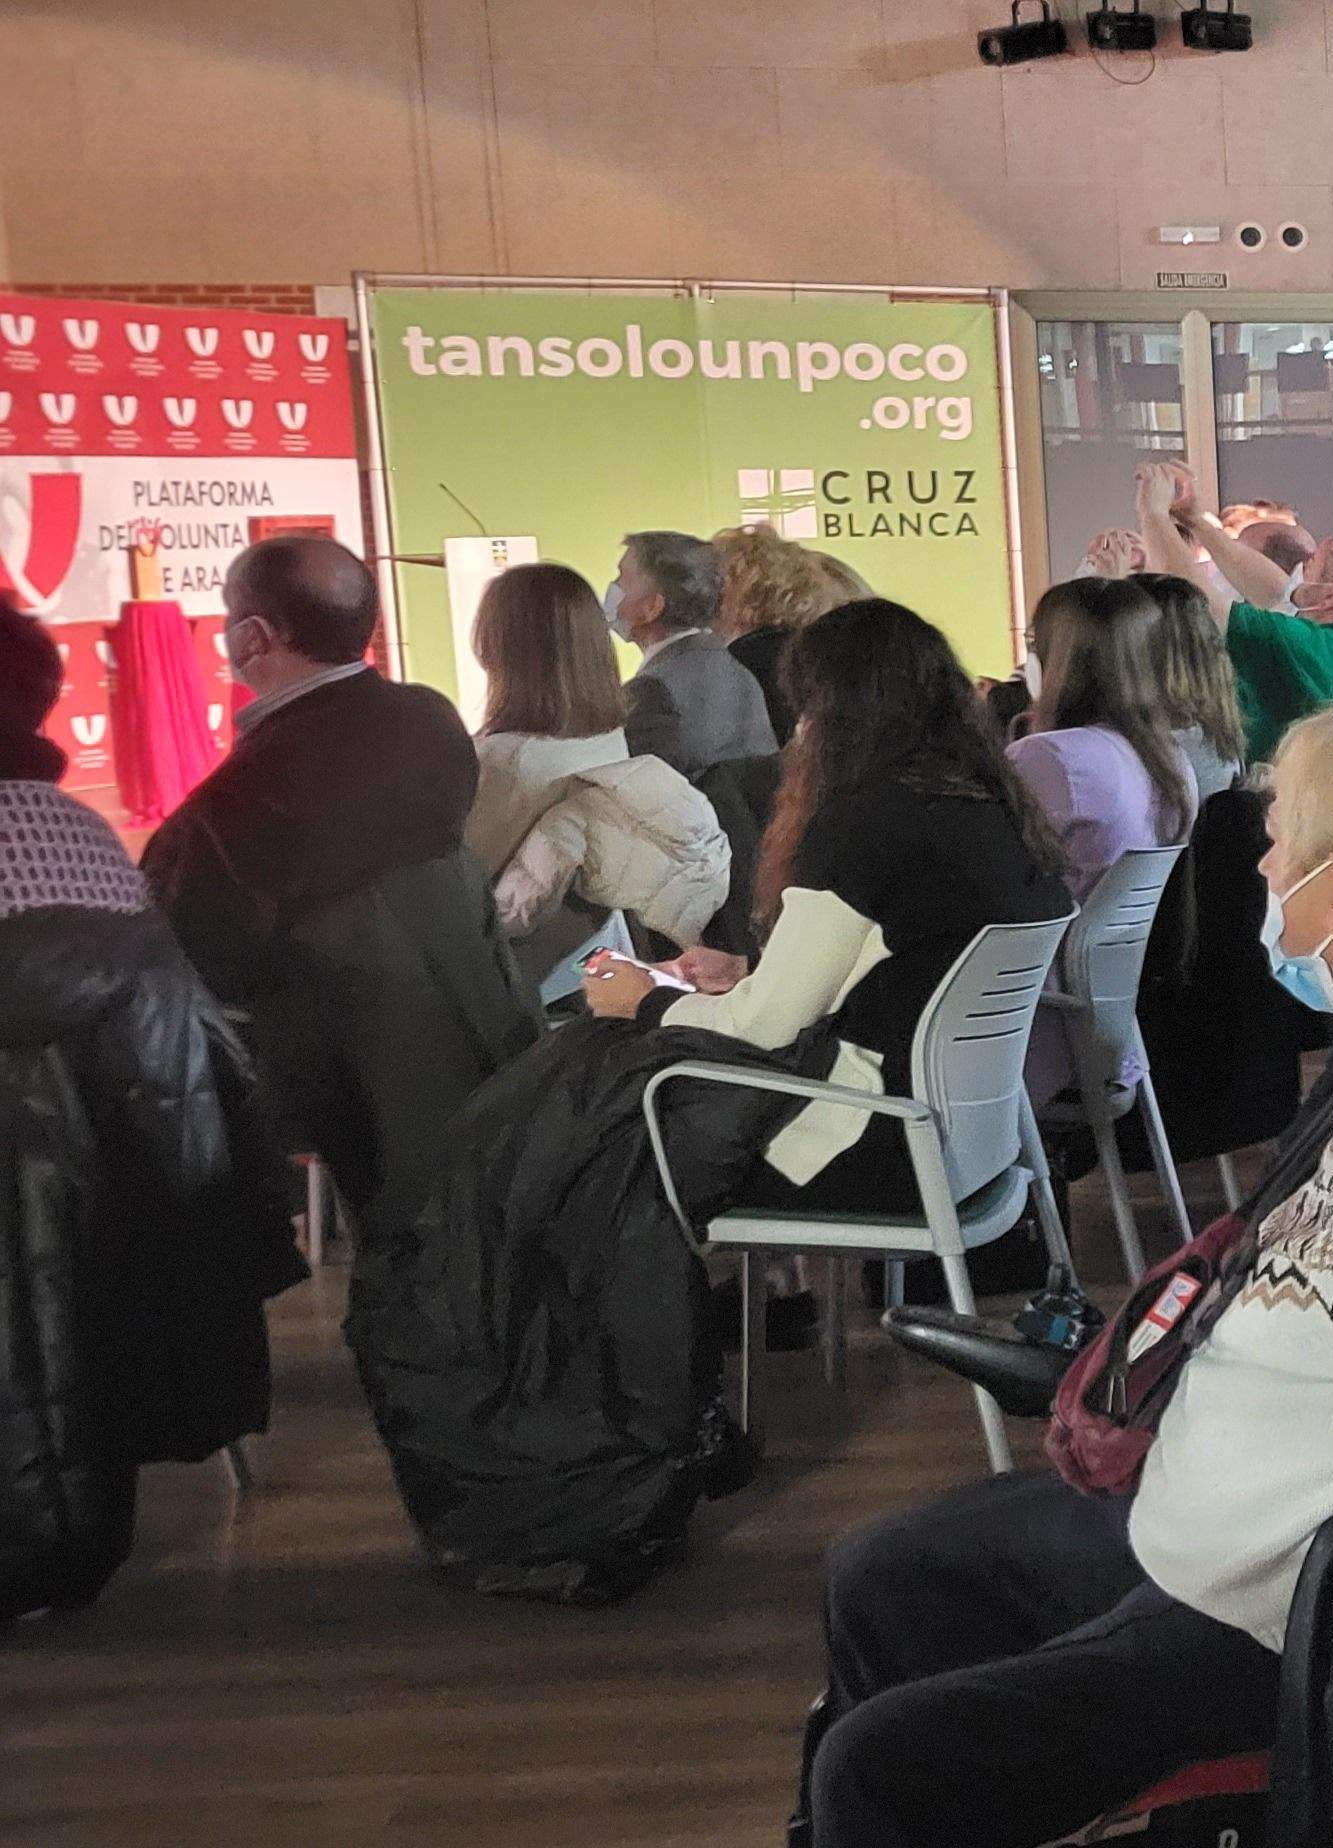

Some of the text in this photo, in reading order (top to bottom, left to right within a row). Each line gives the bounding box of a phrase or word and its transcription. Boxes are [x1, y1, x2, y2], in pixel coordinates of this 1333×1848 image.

[402, 325, 967, 392] tansolounpoco
[859, 394, 973, 440] .org
[133, 481, 273, 506] PLATAFORMA
[821, 469, 978, 505] CRUZ
[823, 512, 979, 538] BLANCA
[180, 566, 224, 592] ARA
